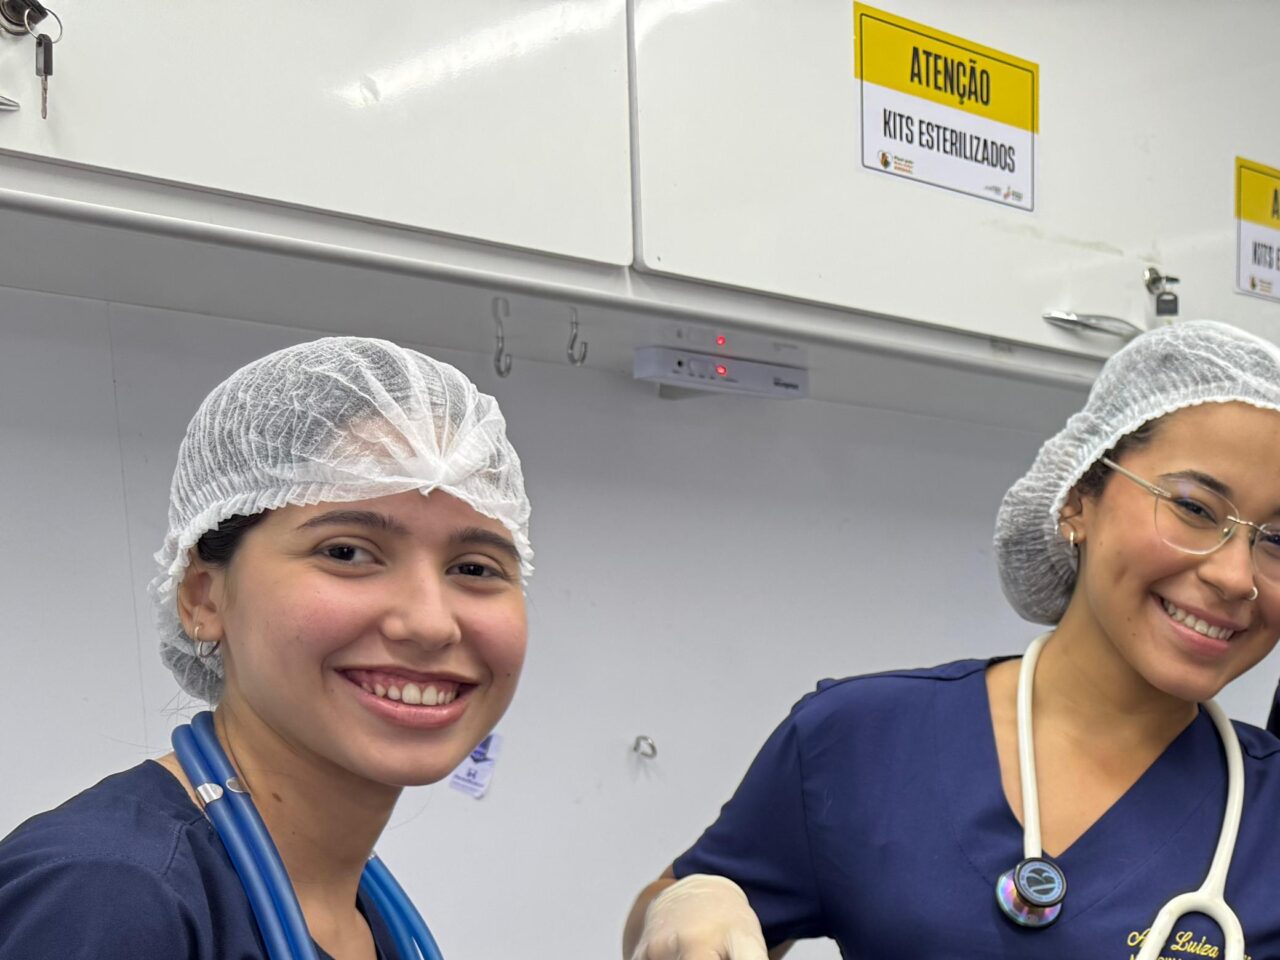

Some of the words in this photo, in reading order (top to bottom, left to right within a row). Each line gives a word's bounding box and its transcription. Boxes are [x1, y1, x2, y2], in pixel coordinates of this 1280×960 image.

[910, 46, 990, 106] ATENÇÃO
[883, 108, 914, 144] KITS
[919, 119, 1015, 173] ESTERILIZADOS
[1252, 241, 1274, 269] KITS
[1170, 931, 1219, 958] Luiza
